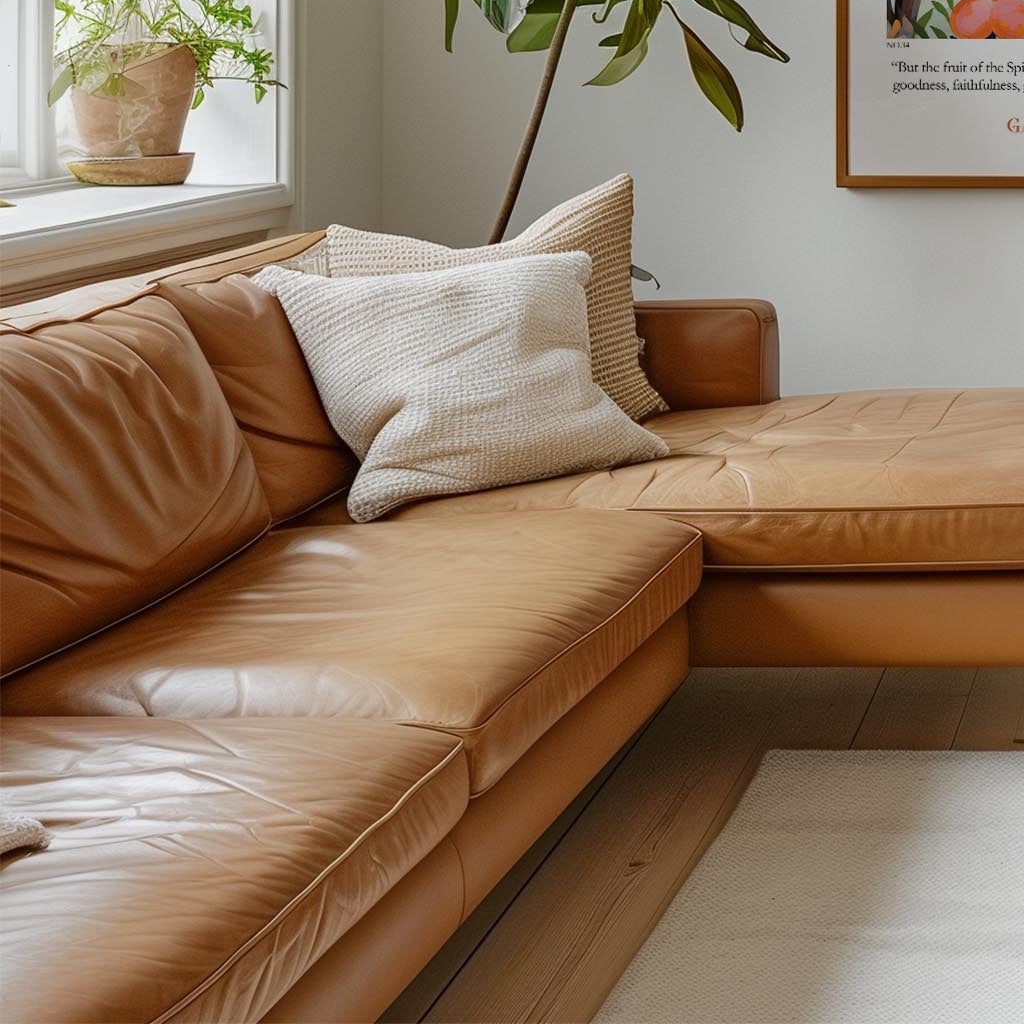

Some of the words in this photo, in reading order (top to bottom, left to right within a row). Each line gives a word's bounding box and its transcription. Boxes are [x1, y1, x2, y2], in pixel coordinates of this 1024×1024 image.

[891, 61, 919, 73] “But
[922, 61, 940, 73] the
[943, 61, 967, 73] fruit
[970, 61, 985, 73] of
[986, 61, 1004, 73] the
[892, 79, 949, 94] goodness,
[952, 79, 1020, 92] faithfulness,
